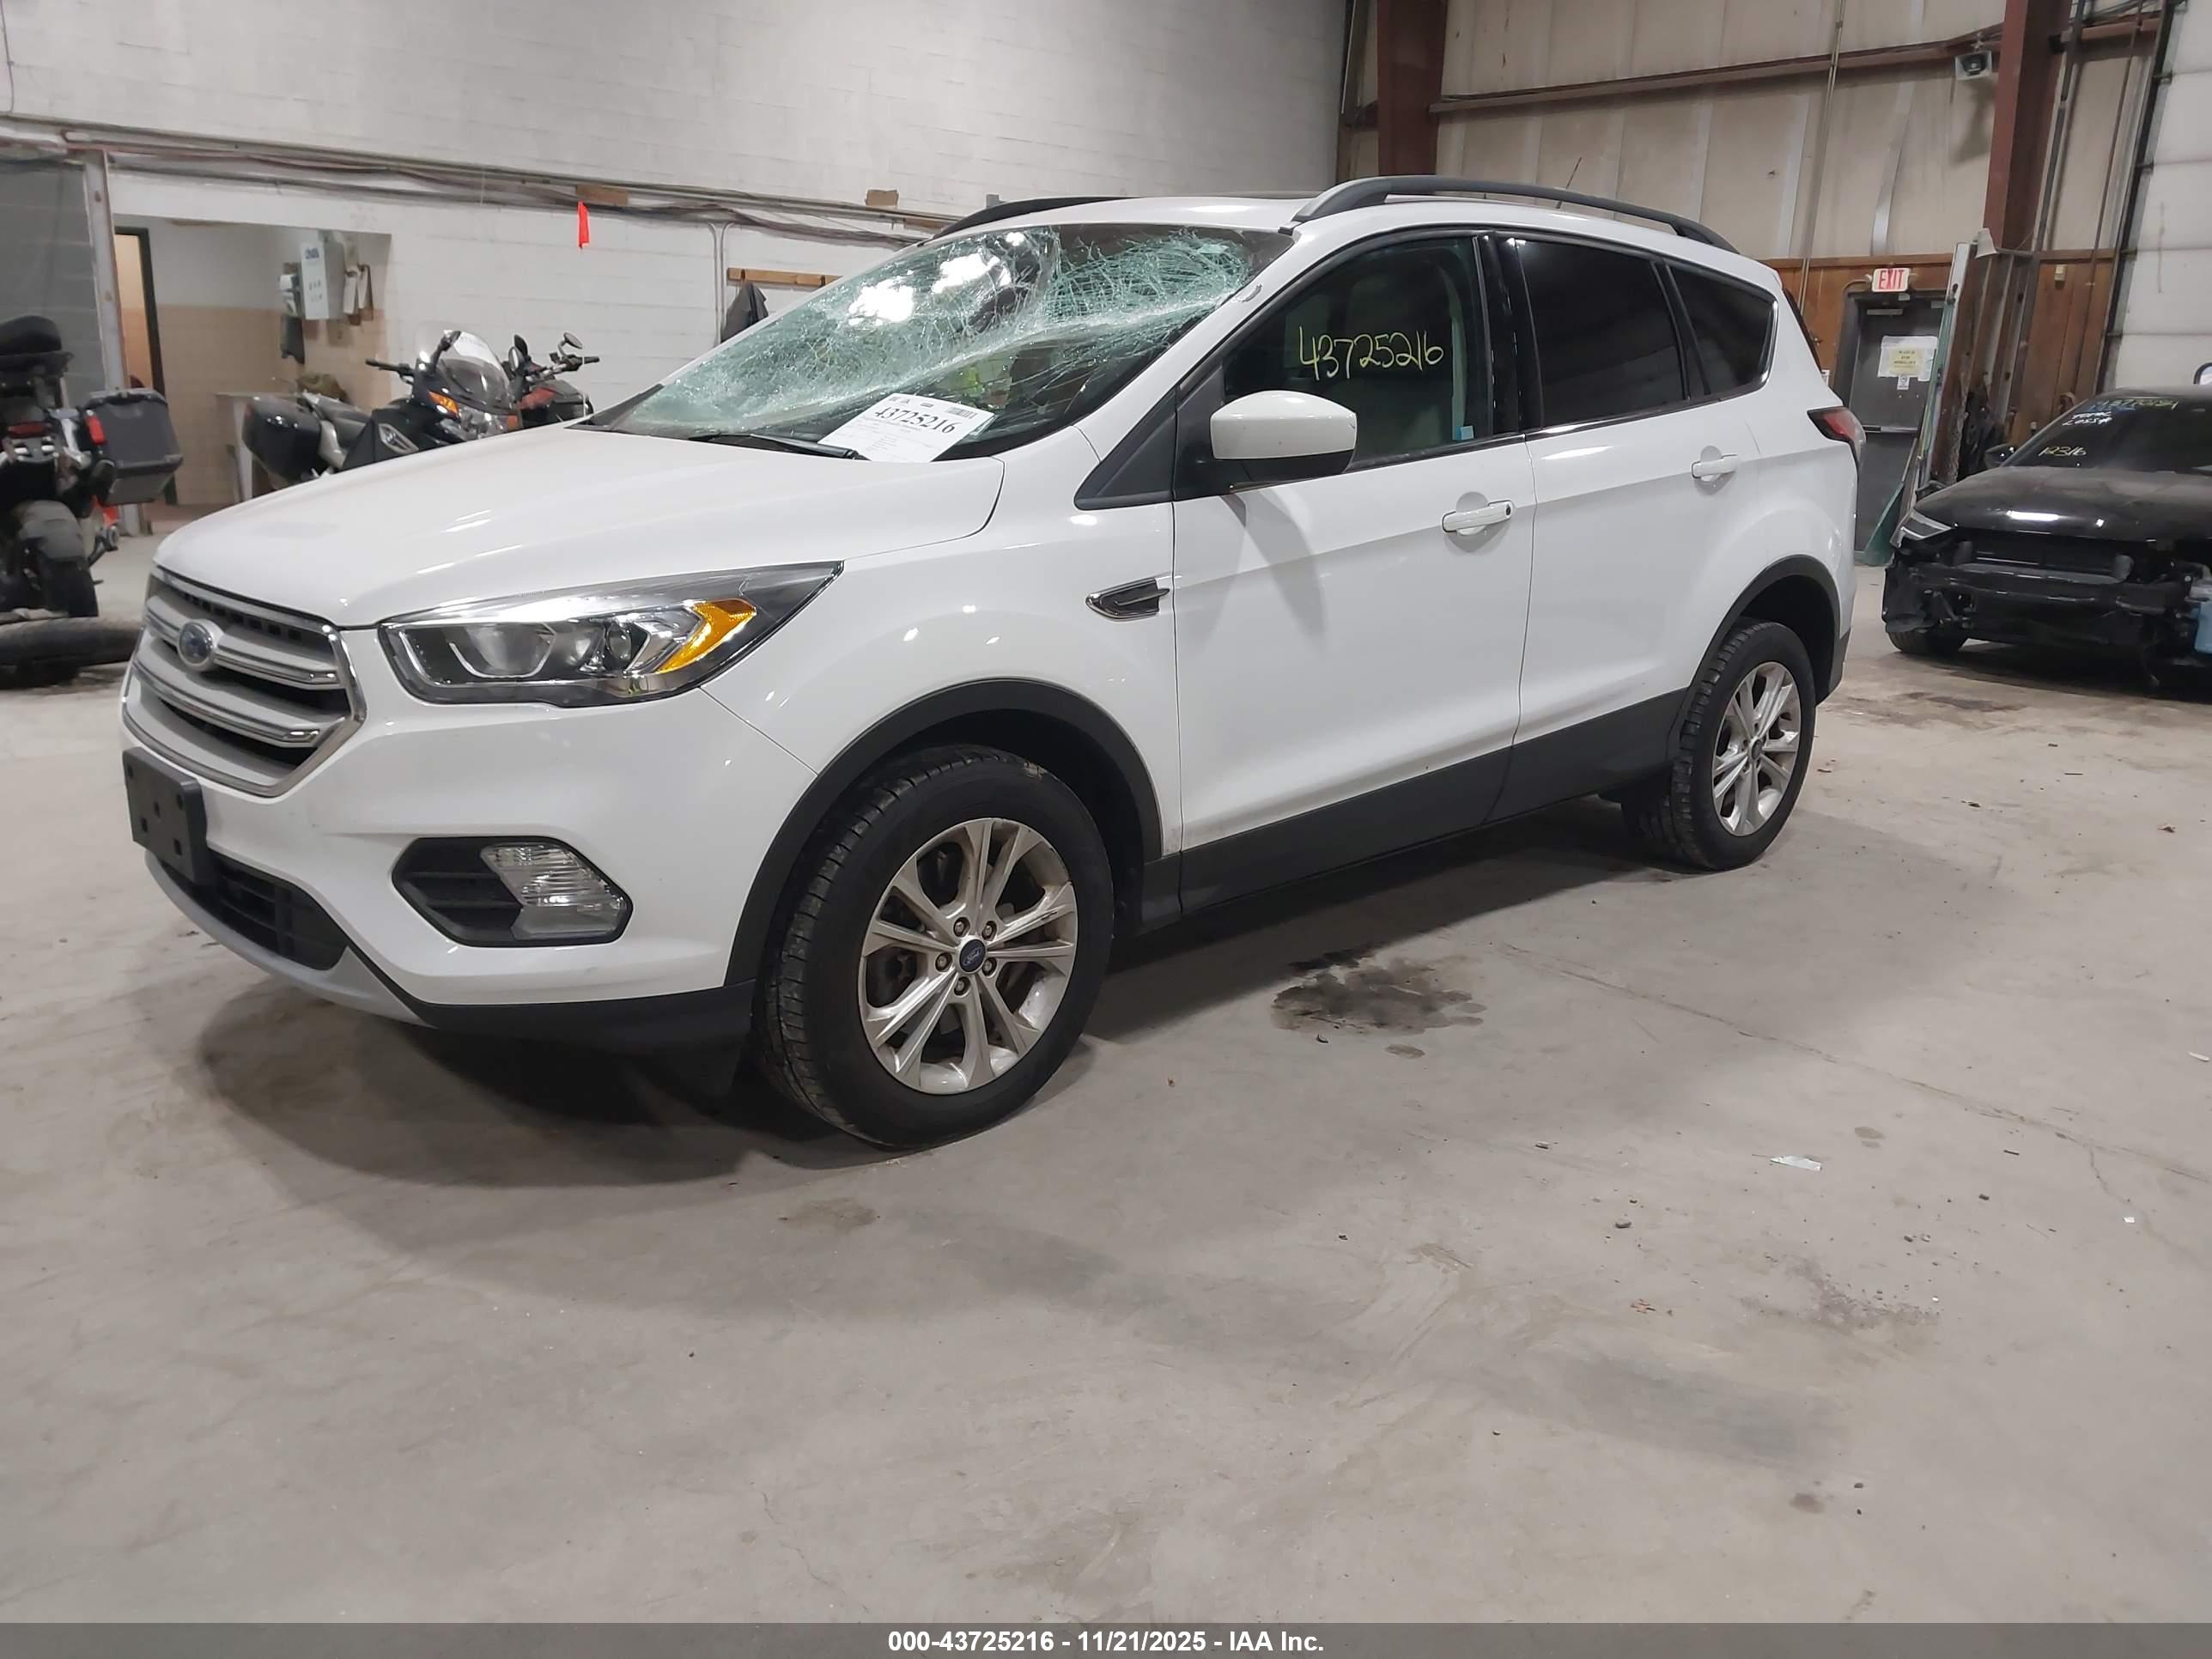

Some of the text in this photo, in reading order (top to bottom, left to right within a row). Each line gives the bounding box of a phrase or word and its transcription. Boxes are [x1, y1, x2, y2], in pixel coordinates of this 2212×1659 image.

[1878, 270, 1905, 290] EXIT
[1298, 325, 1444, 381] 43725216
[874, 406, 958, 434] 43725216
